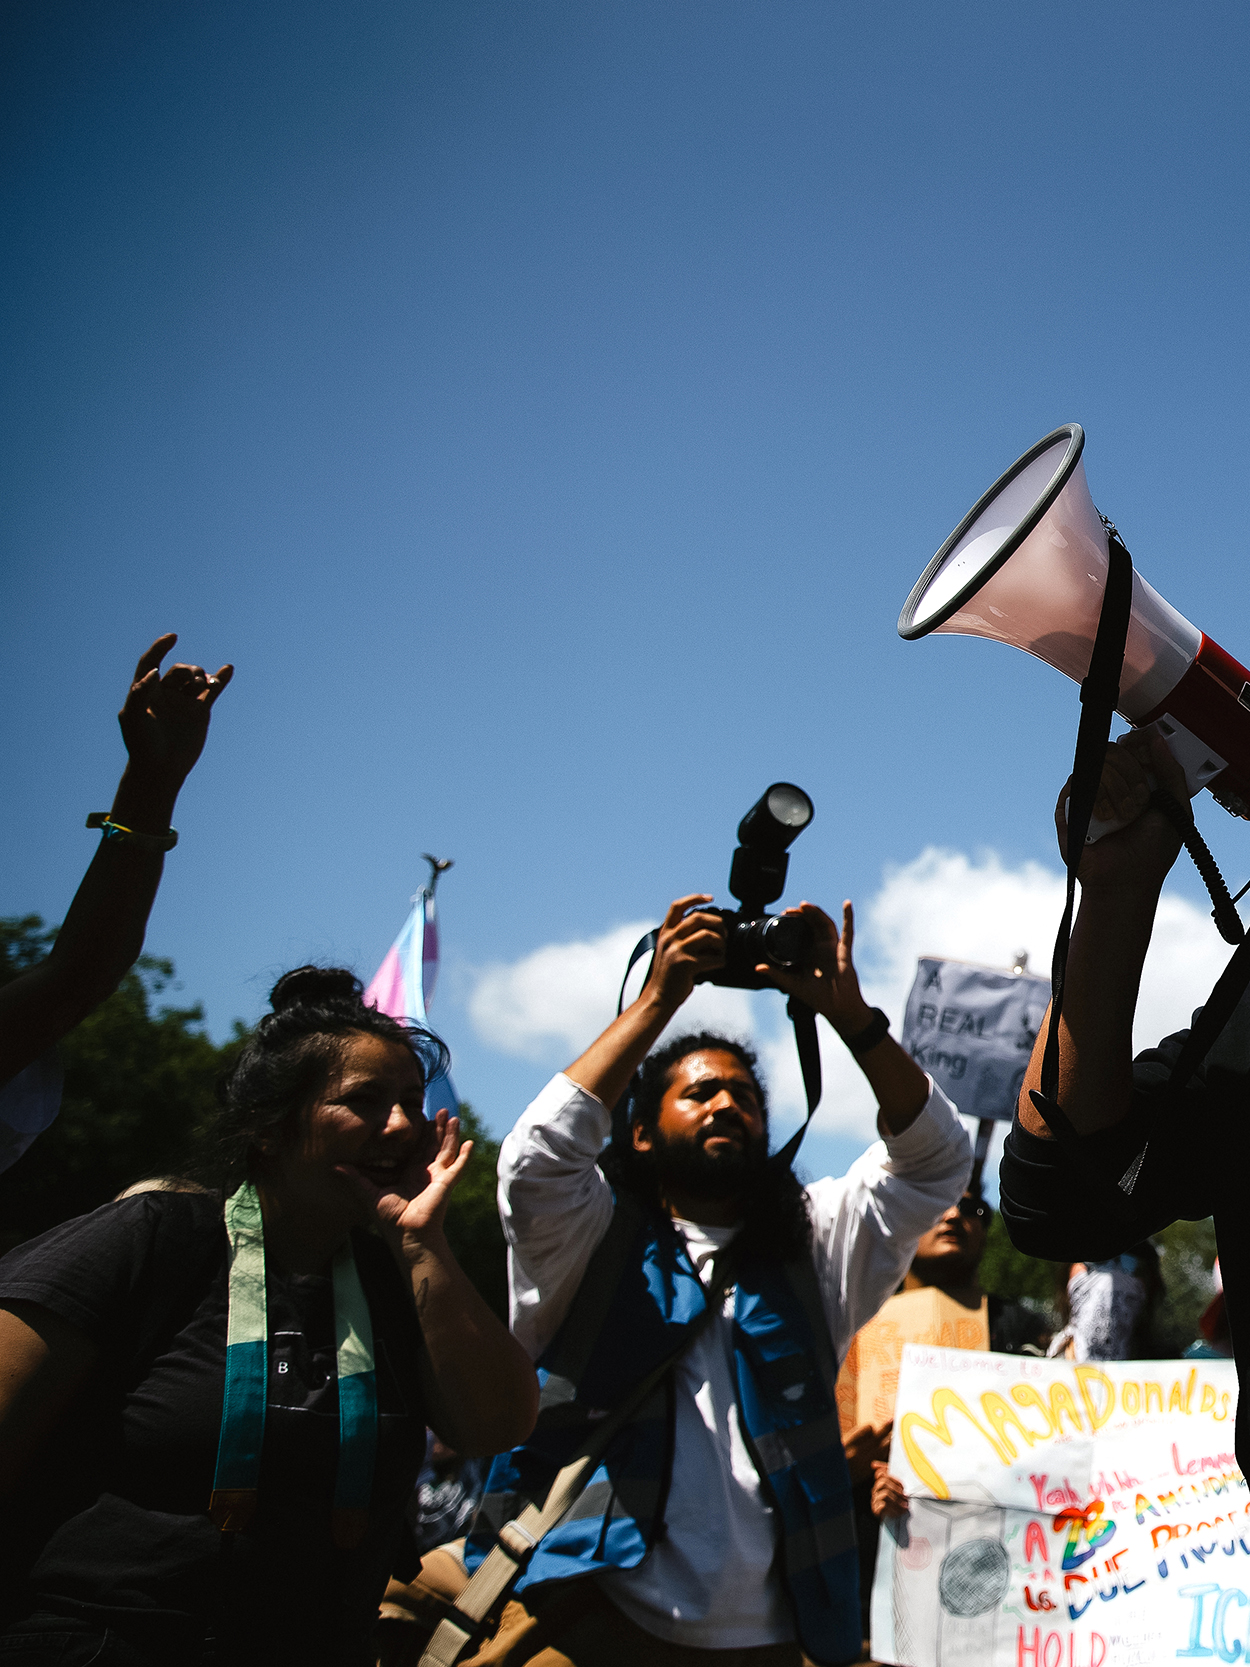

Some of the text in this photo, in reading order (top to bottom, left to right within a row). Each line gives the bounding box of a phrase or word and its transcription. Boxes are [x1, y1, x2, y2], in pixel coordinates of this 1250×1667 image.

[924, 969, 942, 991] A
[910, 1042, 969, 1081] King
[278, 1361, 289, 1375] B
[908, 1349, 1042, 1378] Welcome to
[1025, 1521, 1048, 1563] A
[1064, 1548, 1146, 1620] DUE
[1018, 1625, 1106, 1667] HOLD
